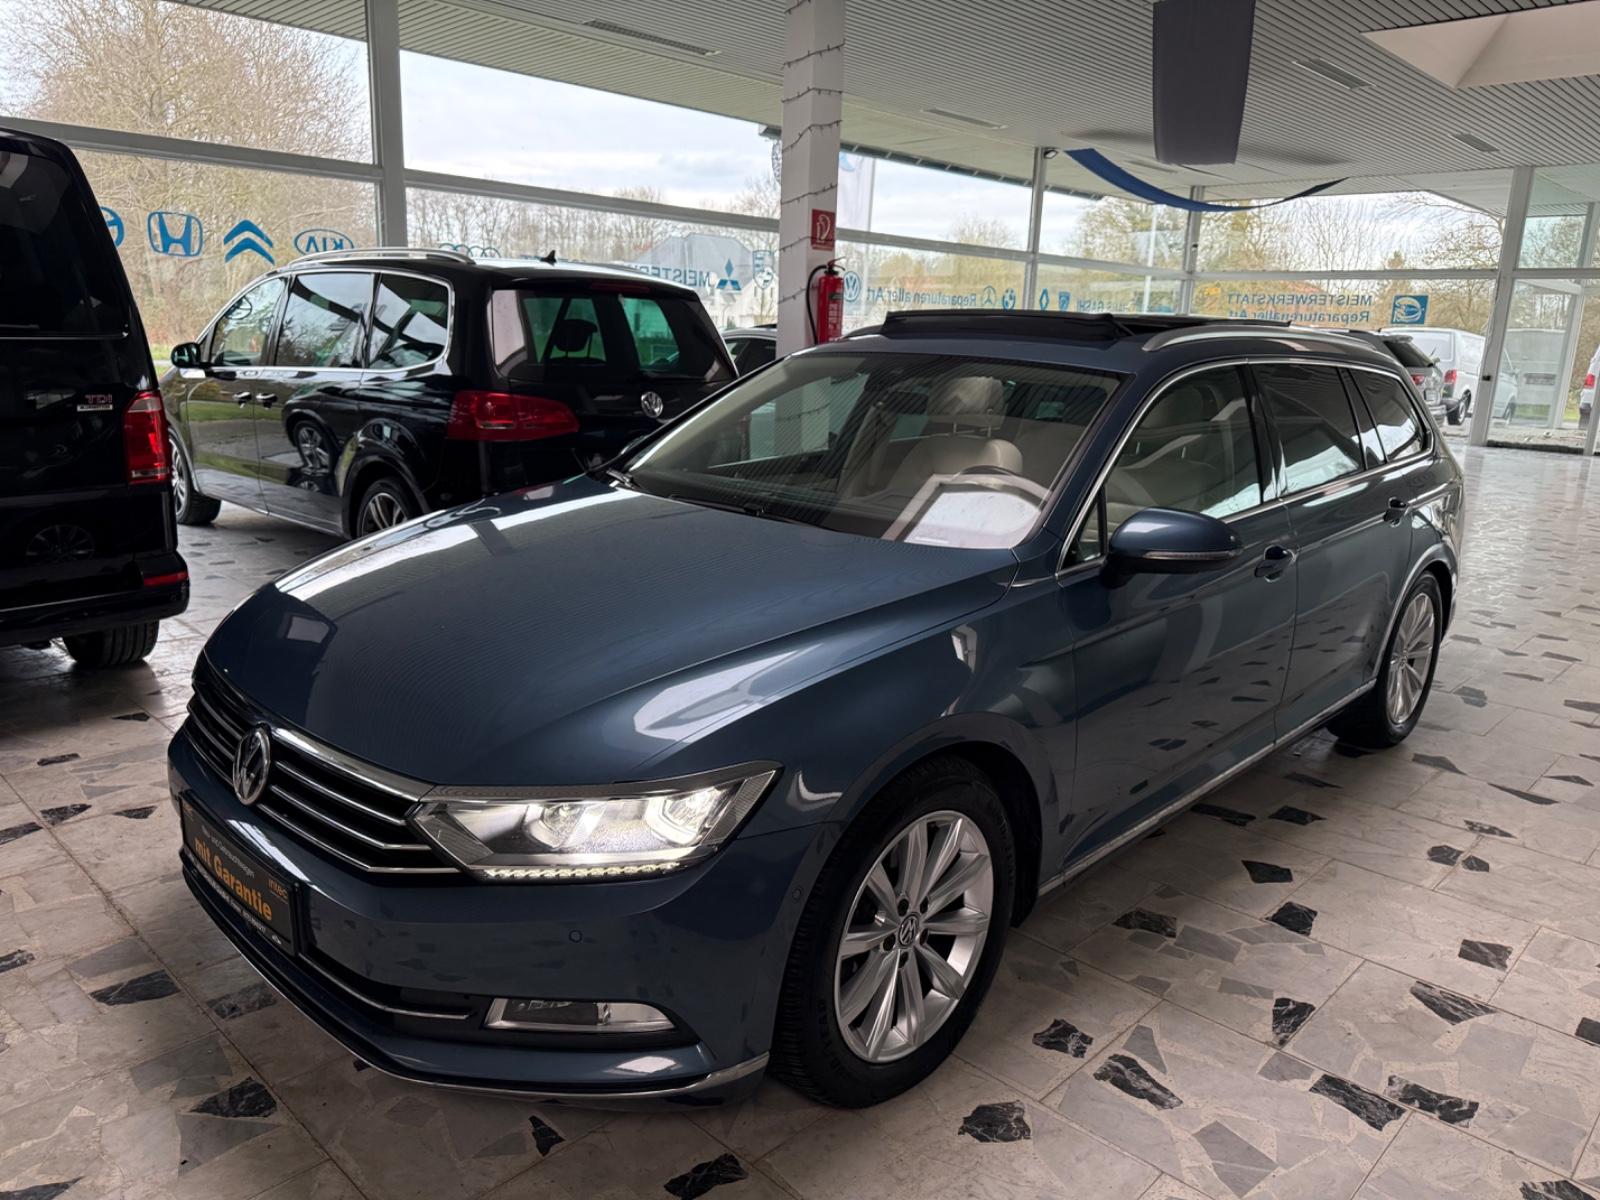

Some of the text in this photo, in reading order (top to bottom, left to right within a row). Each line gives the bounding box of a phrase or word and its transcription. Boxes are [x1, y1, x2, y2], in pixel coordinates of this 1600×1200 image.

[84, 393, 113, 404] TDI
[194, 837, 212, 868] mit
[213, 854, 273, 921] Garantie
